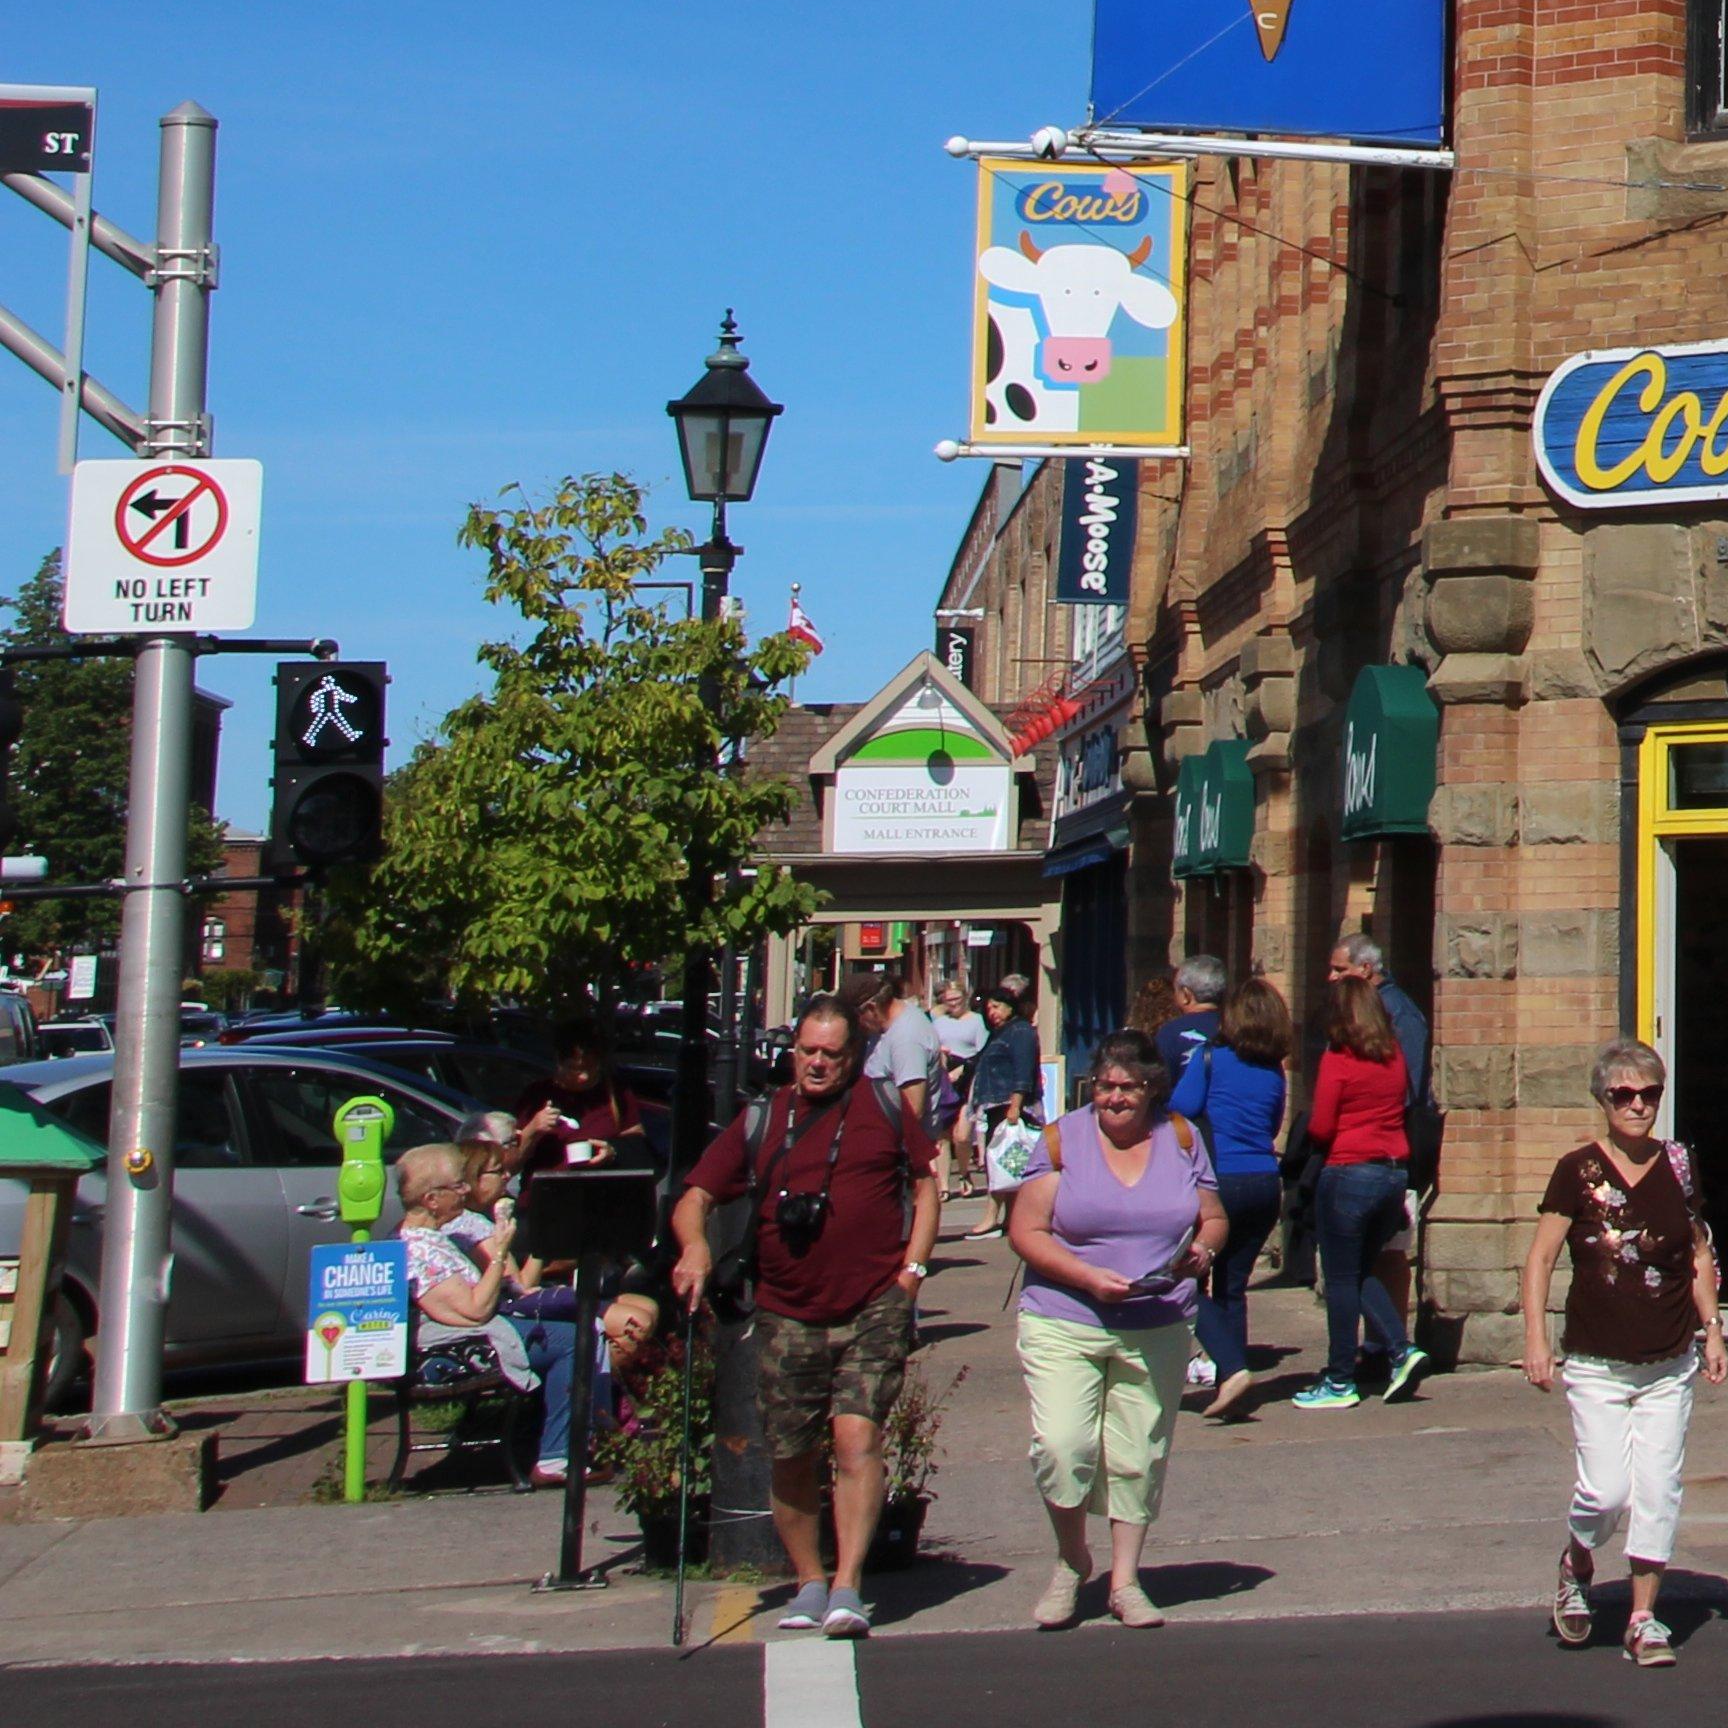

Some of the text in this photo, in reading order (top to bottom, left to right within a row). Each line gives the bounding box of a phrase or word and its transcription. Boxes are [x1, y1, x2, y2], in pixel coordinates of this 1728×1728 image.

[44, 131, 79, 156] ST
[1024, 180, 1141, 222] Cows
[115, 577, 211, 599] NO LEFT
[131, 601, 193, 622] TURN
[844, 787, 971, 802] CONFEDERATION
[858, 801, 956, 815] COURT MALL
[863, 827, 978, 841] MALL ENTRANCE
[323, 1261, 395, 1289] CHANGE
[378, 1284, 393, 1295] LIFE
